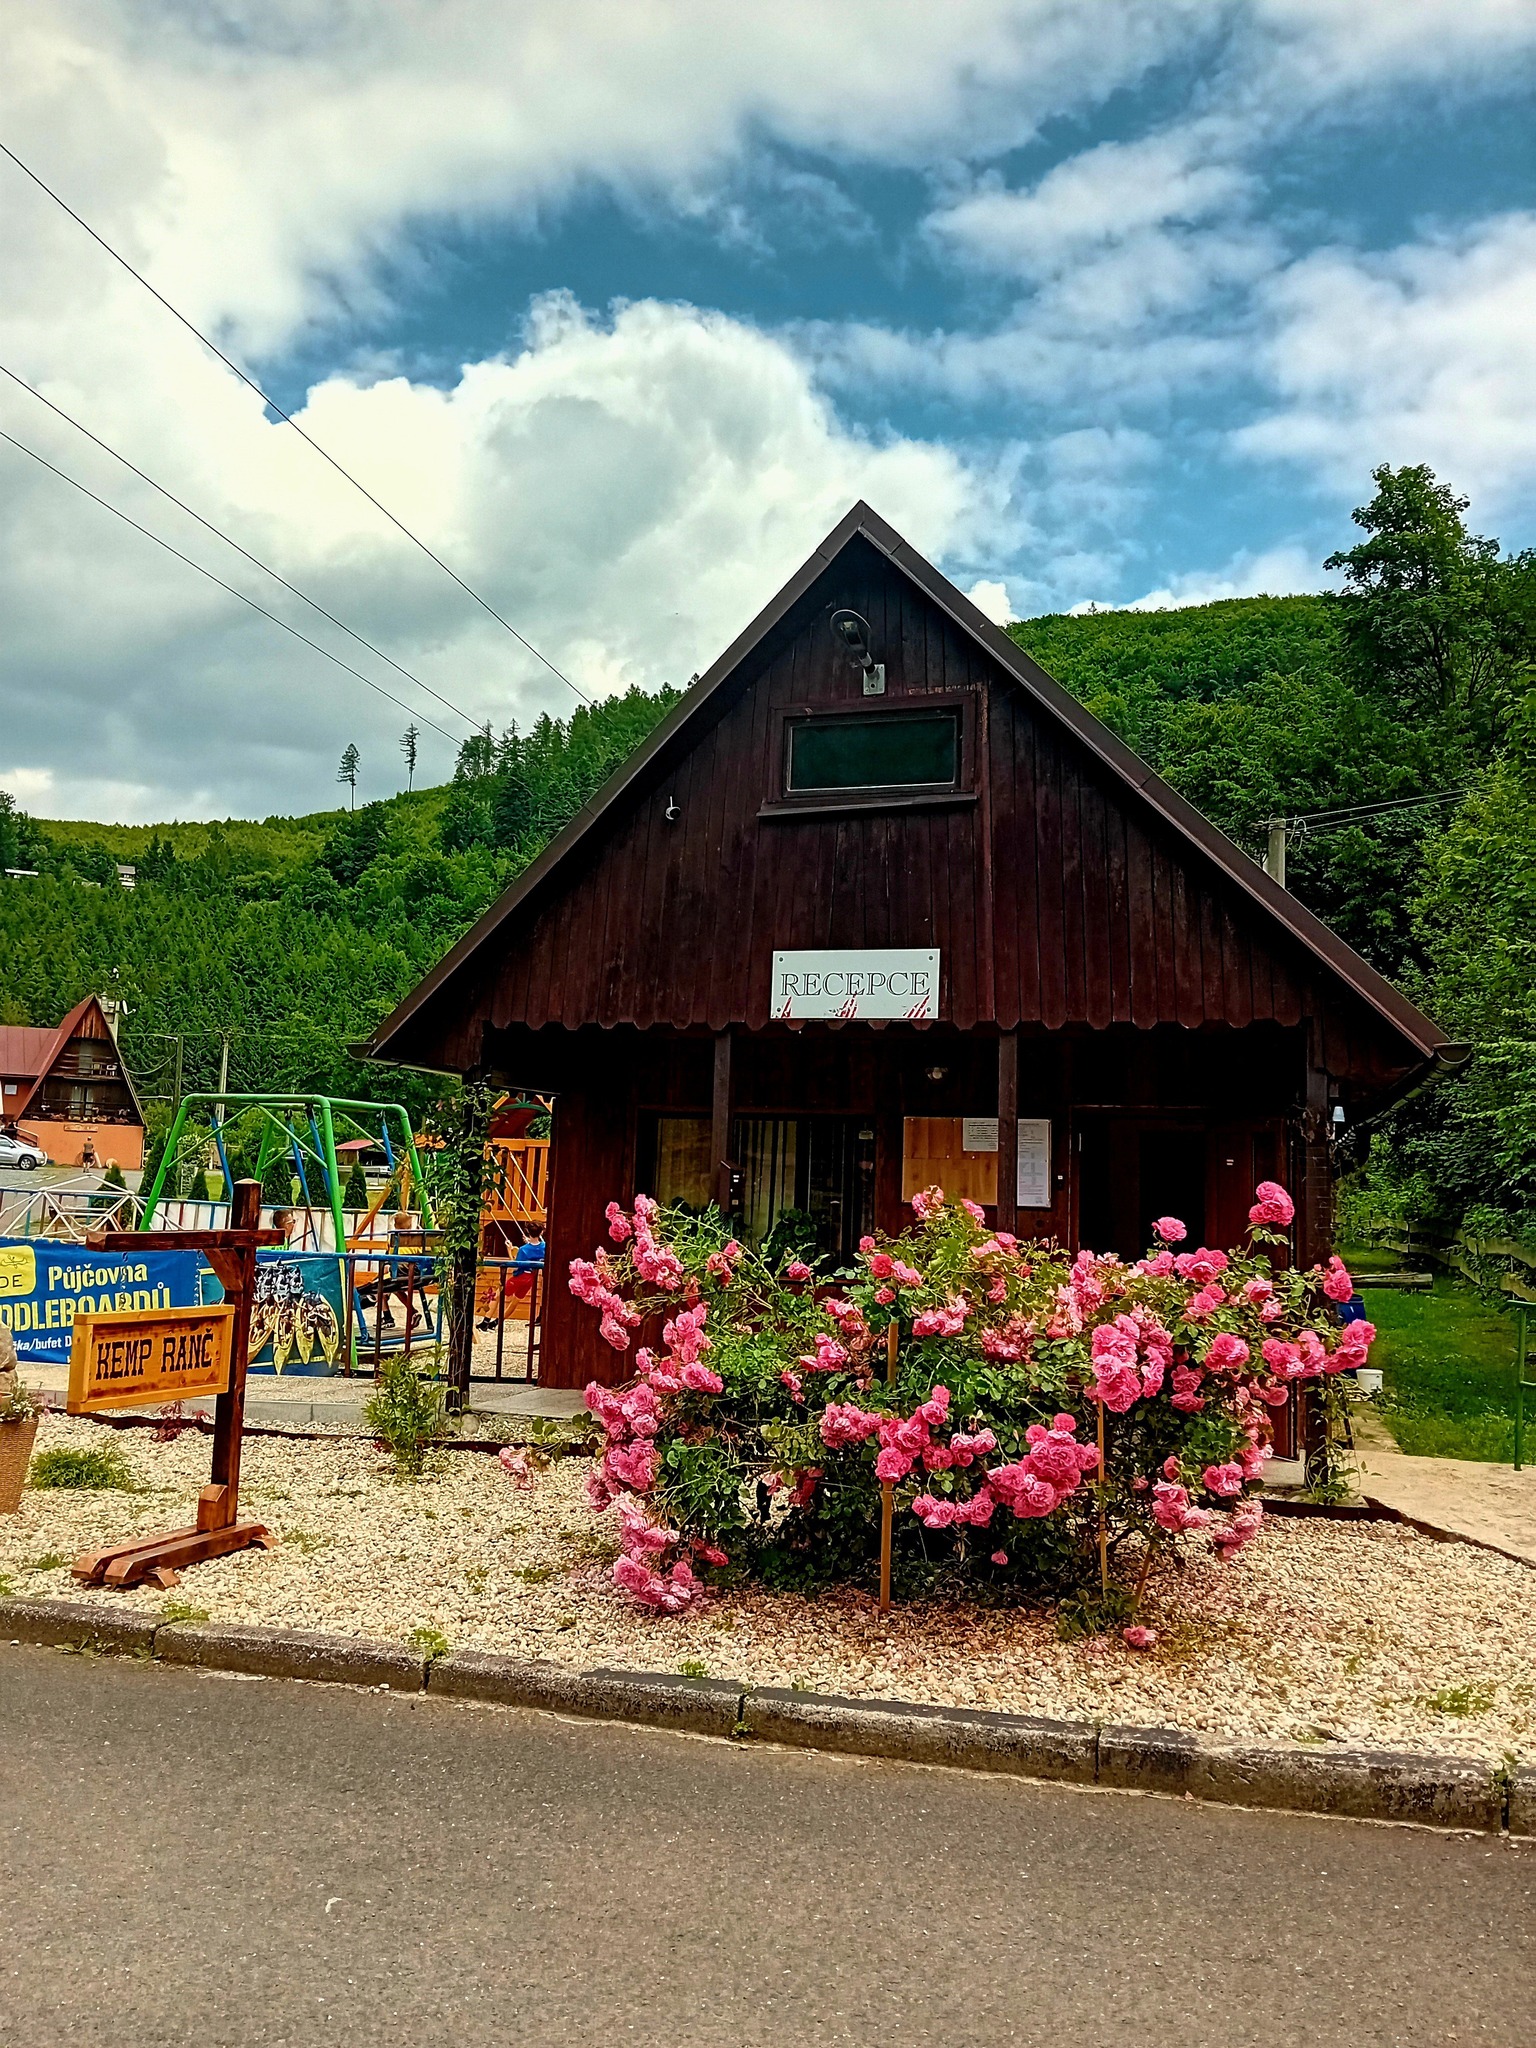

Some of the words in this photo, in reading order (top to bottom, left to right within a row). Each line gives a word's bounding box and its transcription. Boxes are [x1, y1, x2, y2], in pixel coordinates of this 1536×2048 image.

[780, 972, 931, 997] RECEPCE
[48, 1263, 148, 1293] Půjčovna
[95, 1338, 153, 1381] KEMP
[160, 1328, 214, 1373] RANČ
